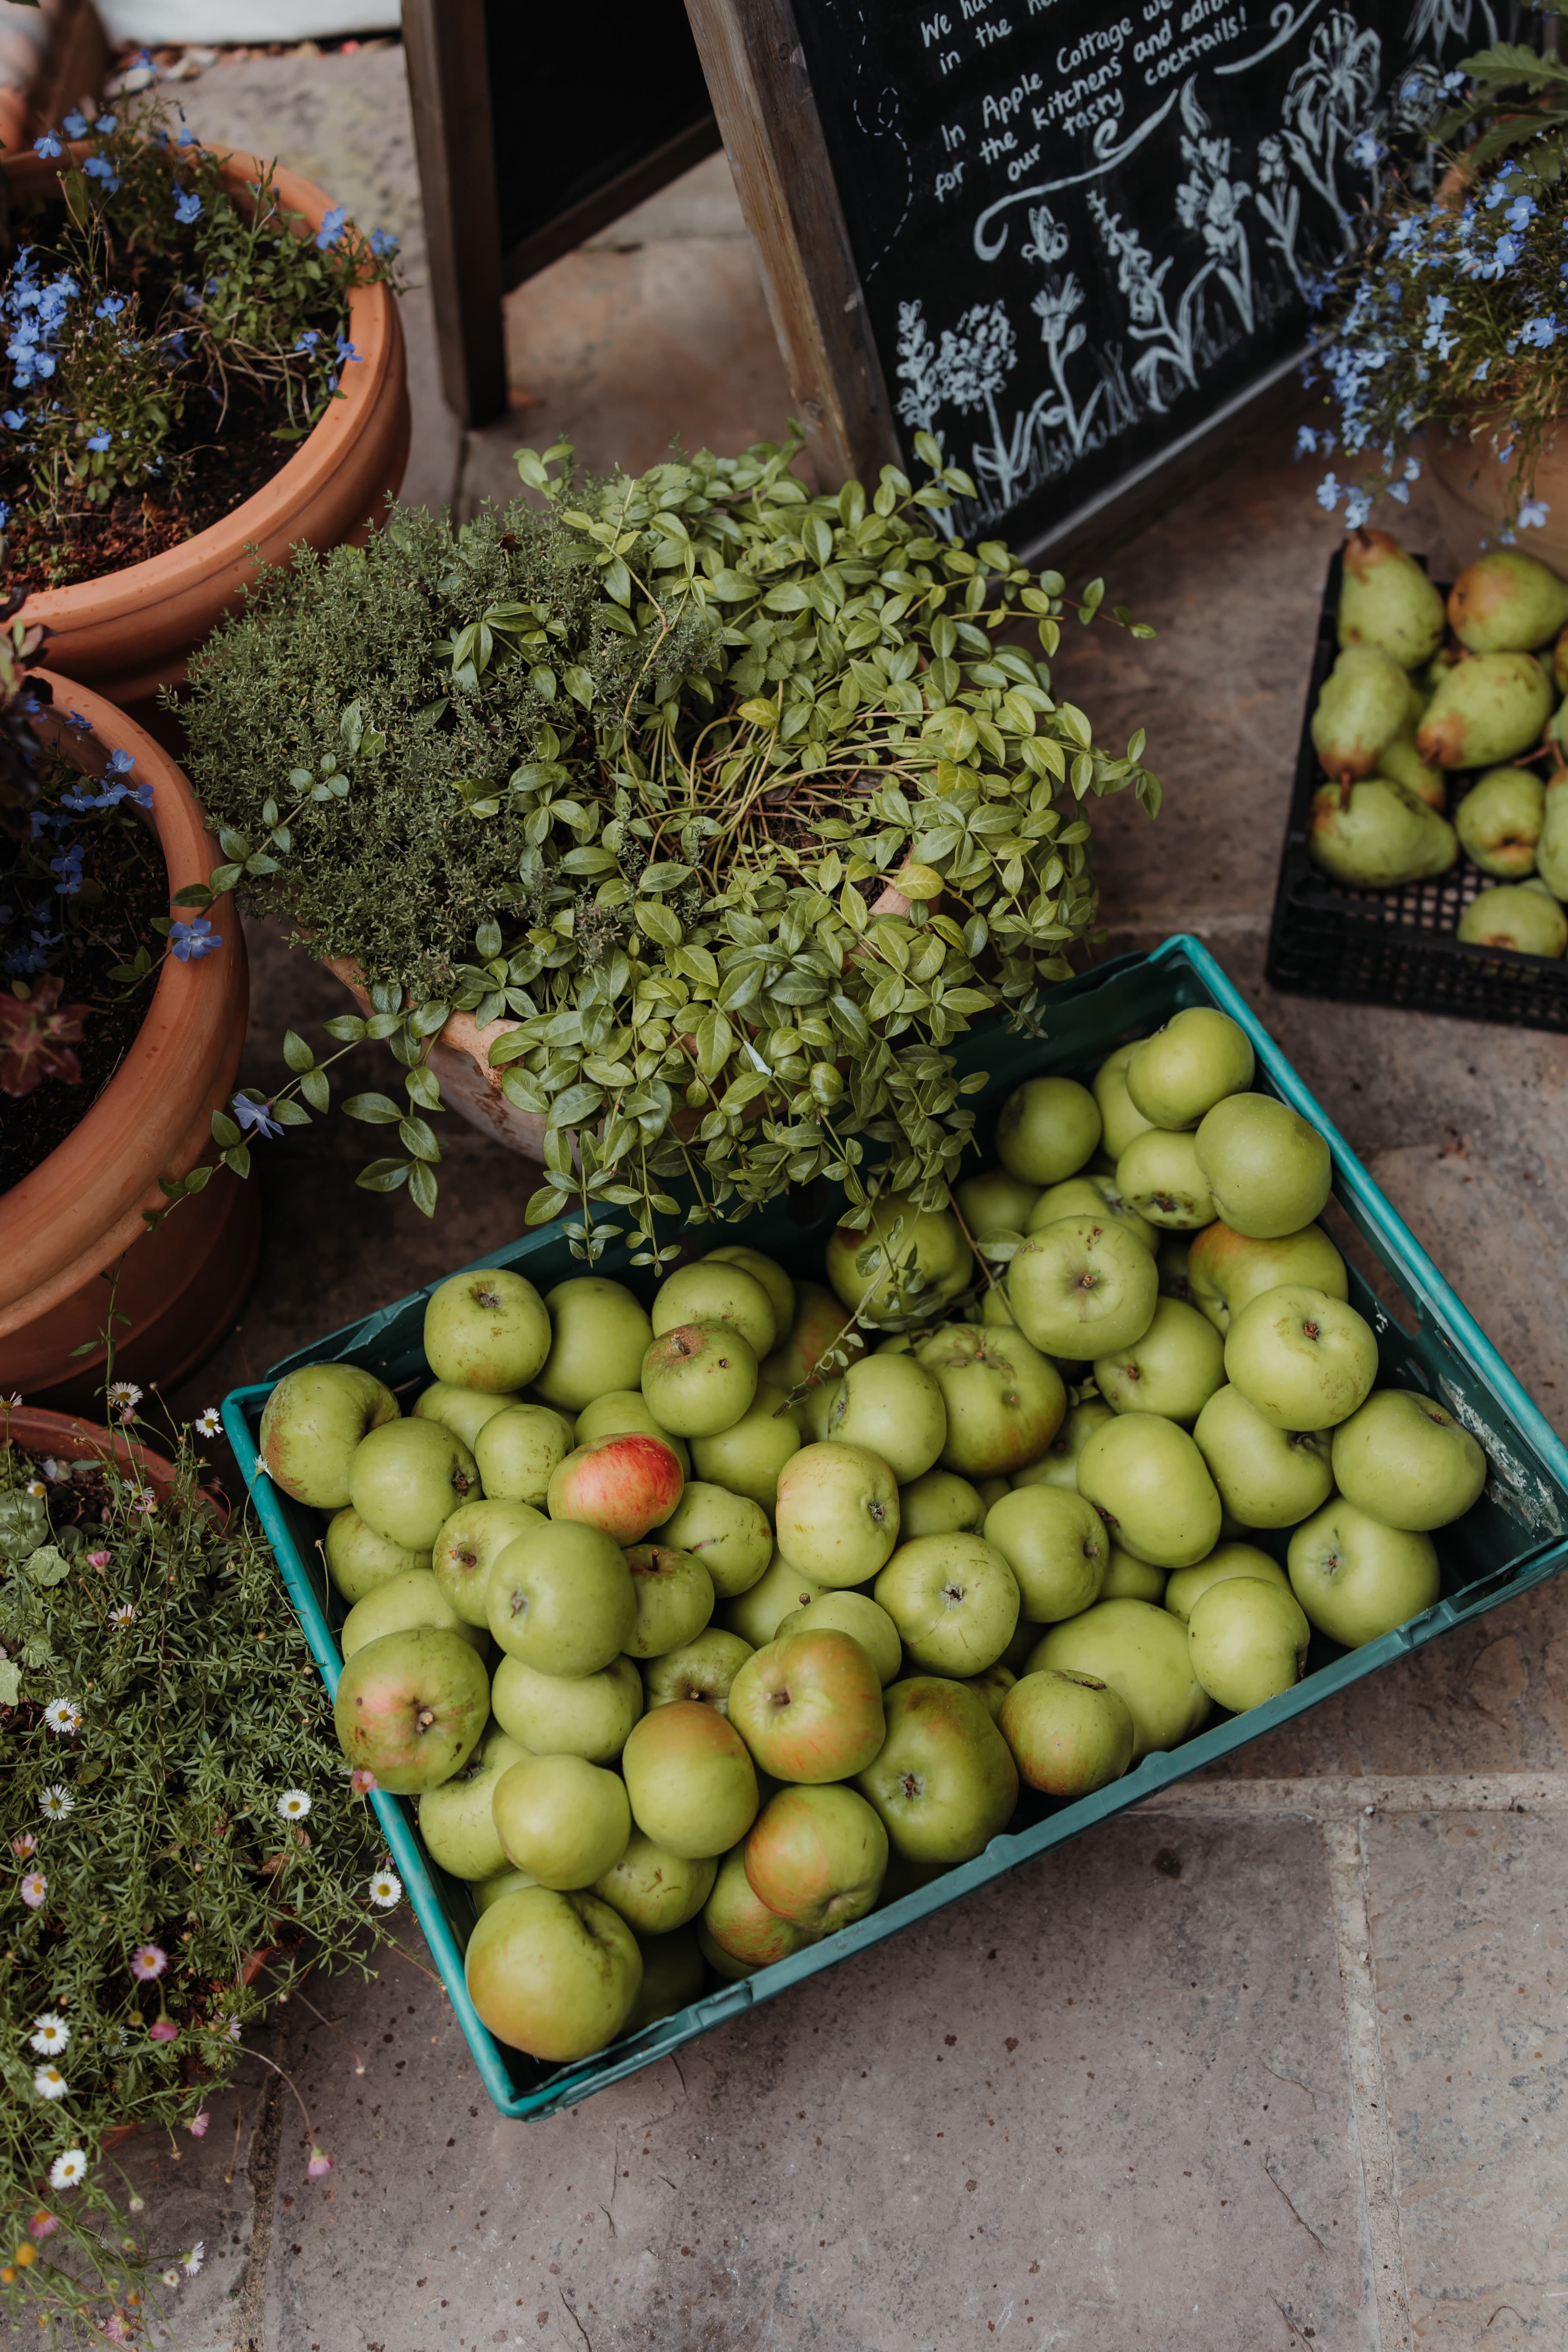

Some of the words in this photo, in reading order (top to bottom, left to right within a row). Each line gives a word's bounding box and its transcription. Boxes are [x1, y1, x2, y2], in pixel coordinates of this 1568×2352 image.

[921, 13, 952, 47] We
[960, 0, 992, 19] ha
[940, 51, 960, 74] in
[975, 19, 1012, 47] the
[941, 125, 965, 151] In
[983, 74, 1042, 128] Apple
[1057, 17, 1133, 74] Cottage
[934, 162, 964, 202] for
[979, 132, 1018, 164] the
[1032, 56, 1122, 130] kitchens
[1133, 18, 1173, 63] and
[1181, 0, 1229, 32] edib
[1008, 144, 1040, 181] our
[1063, 88, 1124, 137] tasty
[1145, 6, 1247, 86] cocktails!
